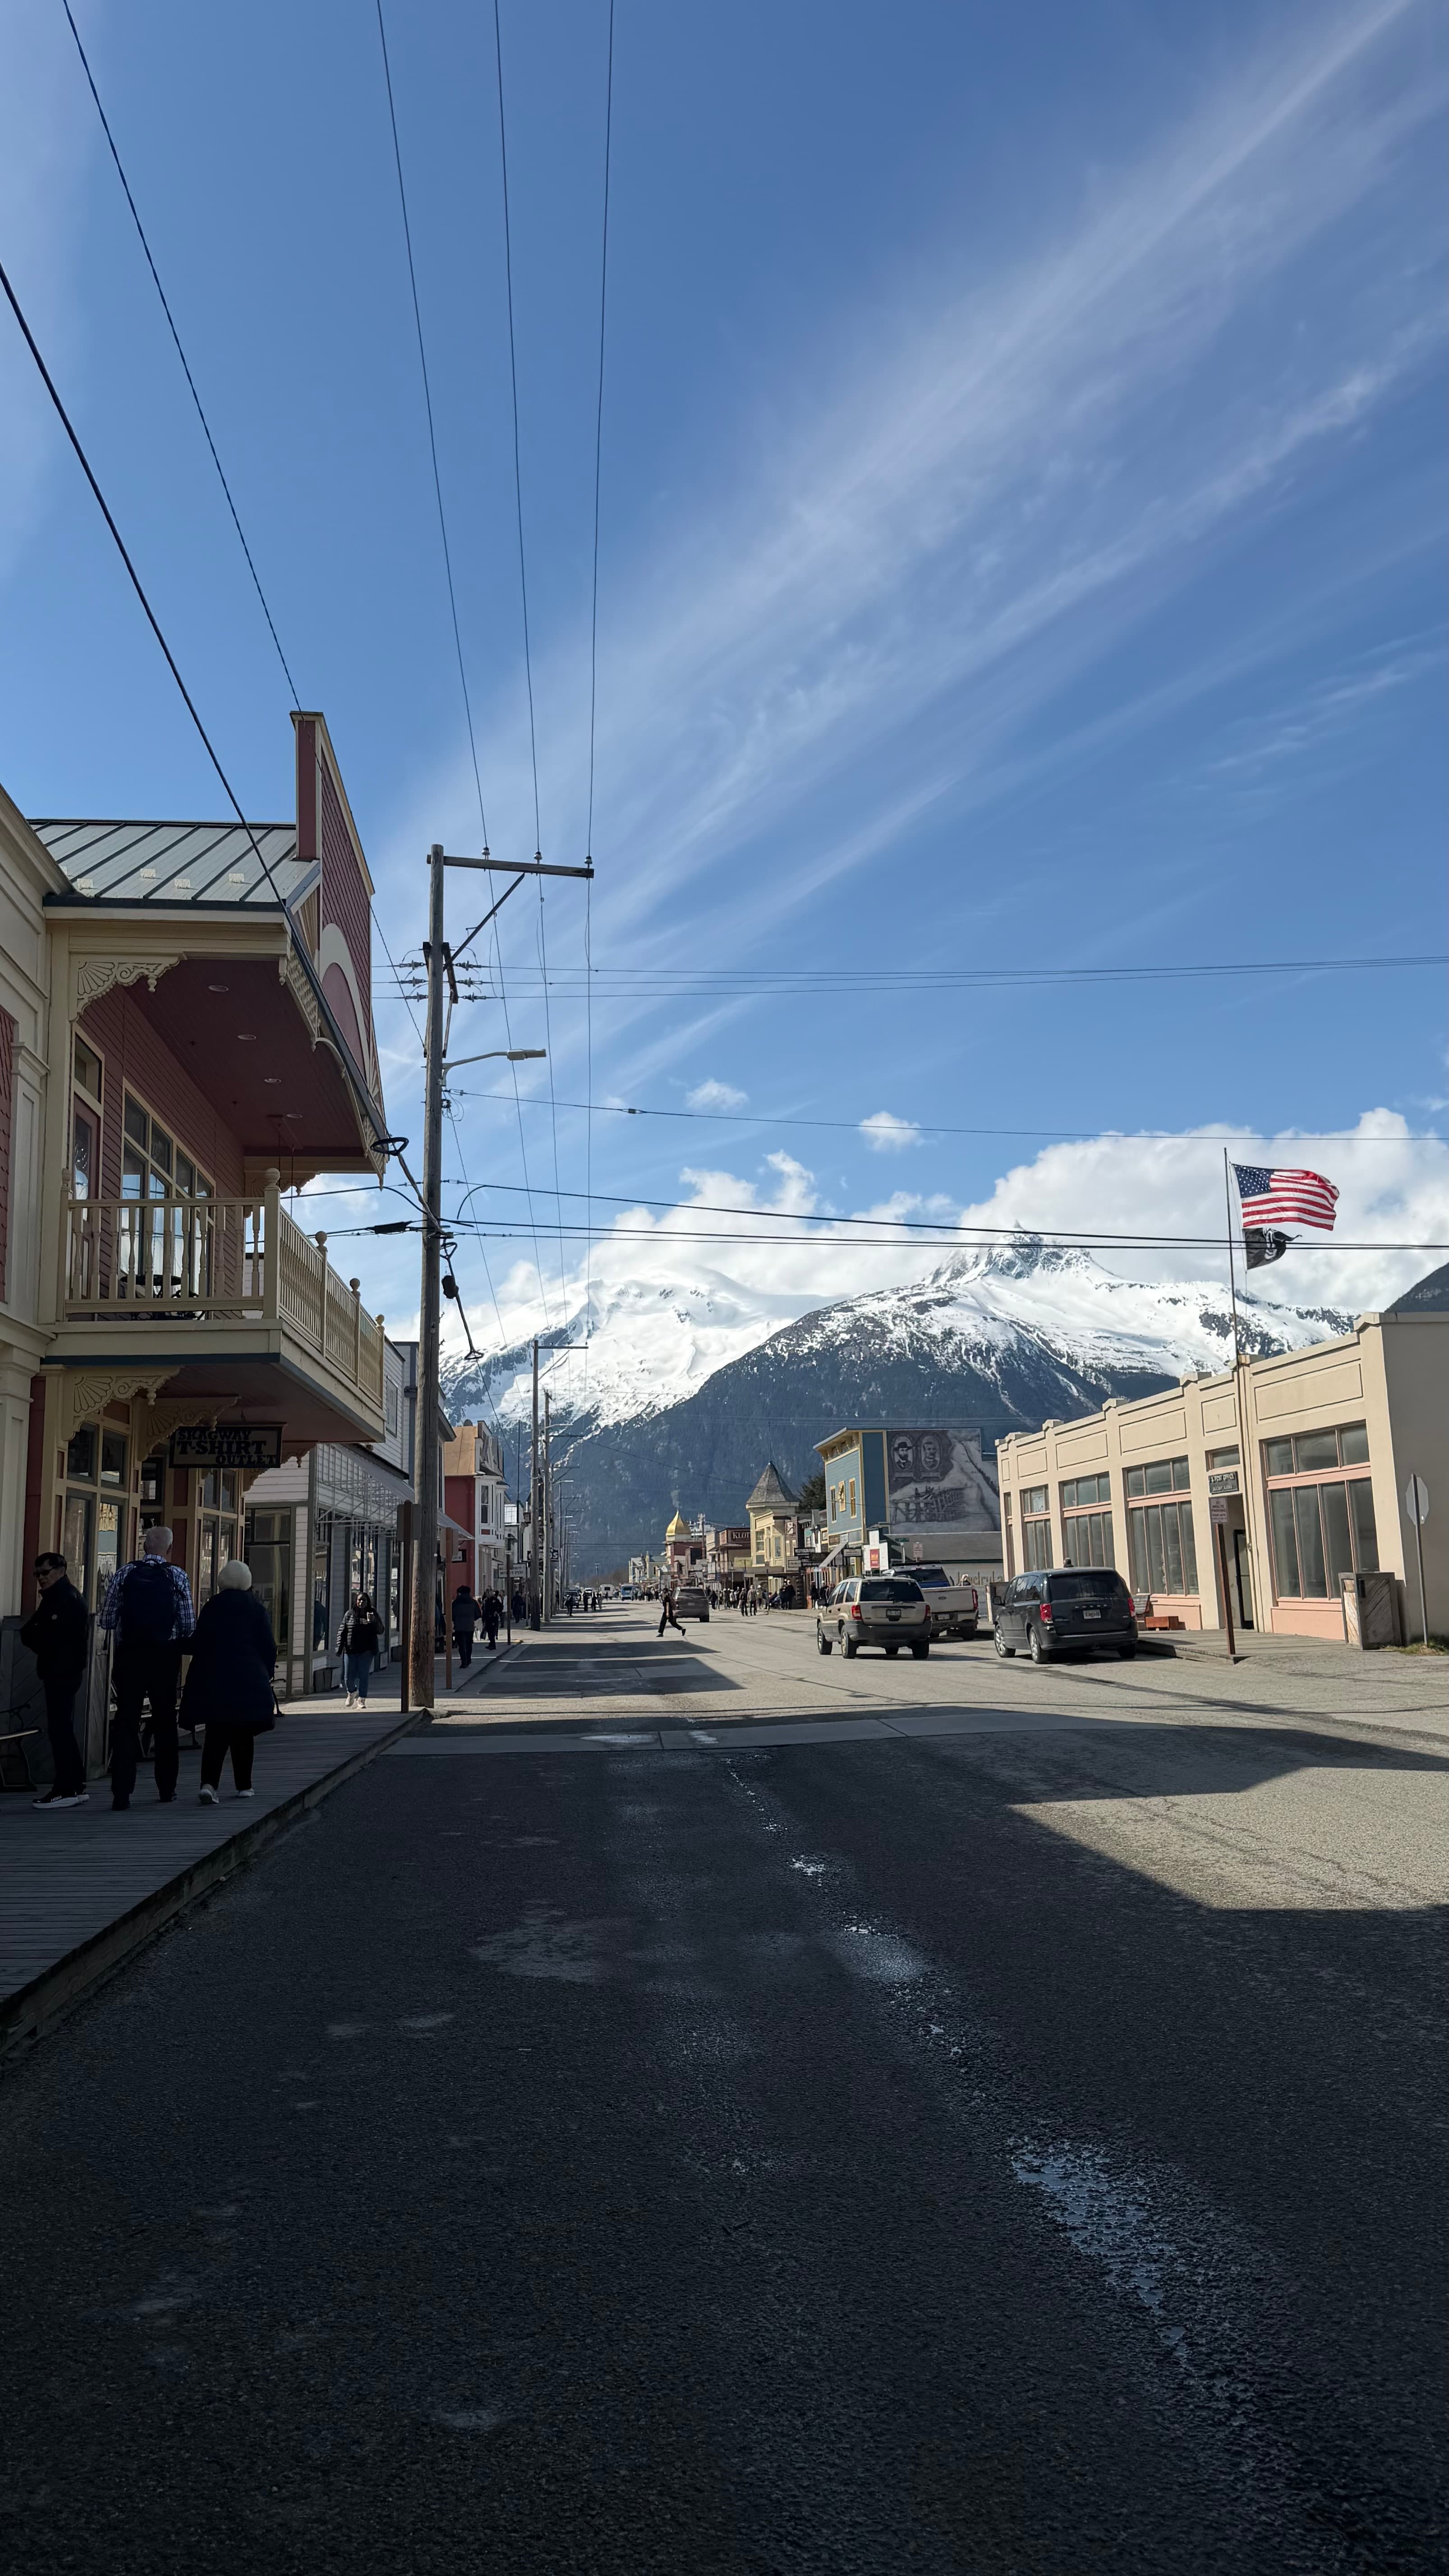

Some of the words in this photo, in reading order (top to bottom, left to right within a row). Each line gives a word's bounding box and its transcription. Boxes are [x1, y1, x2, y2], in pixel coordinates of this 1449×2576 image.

[177, 1429, 251, 1440] SKAGWAY
[177, 1440, 267, 1454] T-SHIRT
[216, 1455, 276, 1465] OUTLET
